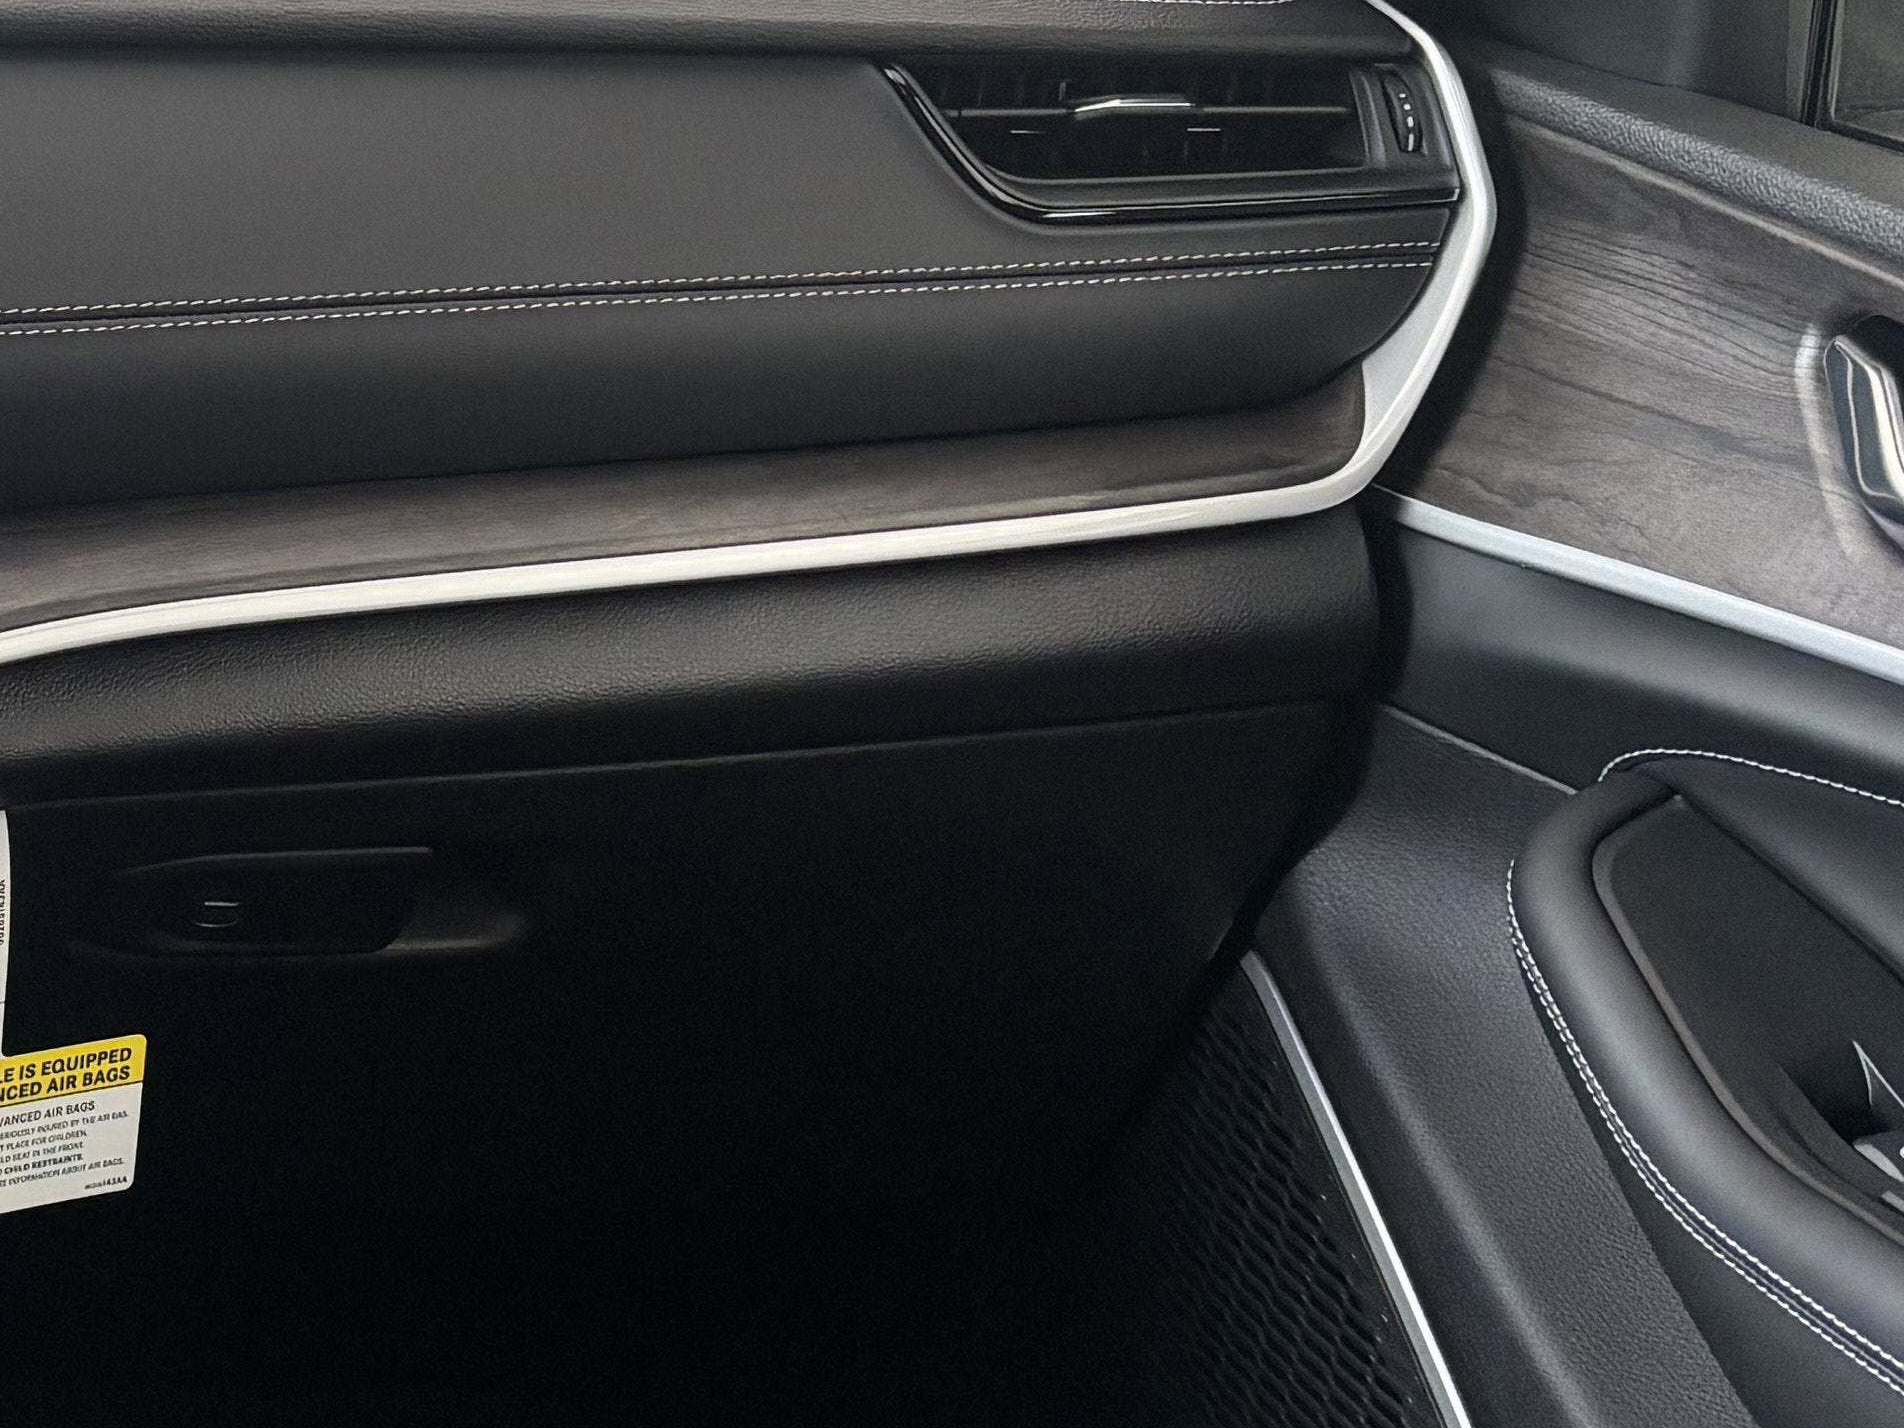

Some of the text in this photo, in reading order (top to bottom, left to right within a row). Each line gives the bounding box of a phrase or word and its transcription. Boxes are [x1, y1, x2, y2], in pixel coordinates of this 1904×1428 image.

[19, 1064, 37, 1080] IS
[41, 1048, 132, 1076] EQUIPPED
[46, 1075, 77, 1094] AIR
[82, 1066, 130, 1086] BAGS
[44, 1106, 63, 1118] AIR
[66, 1101, 95, 1115] BAGS
[6, 1140, 29, 1151] PLACE
[31, 1137, 47, 1145] FOR
